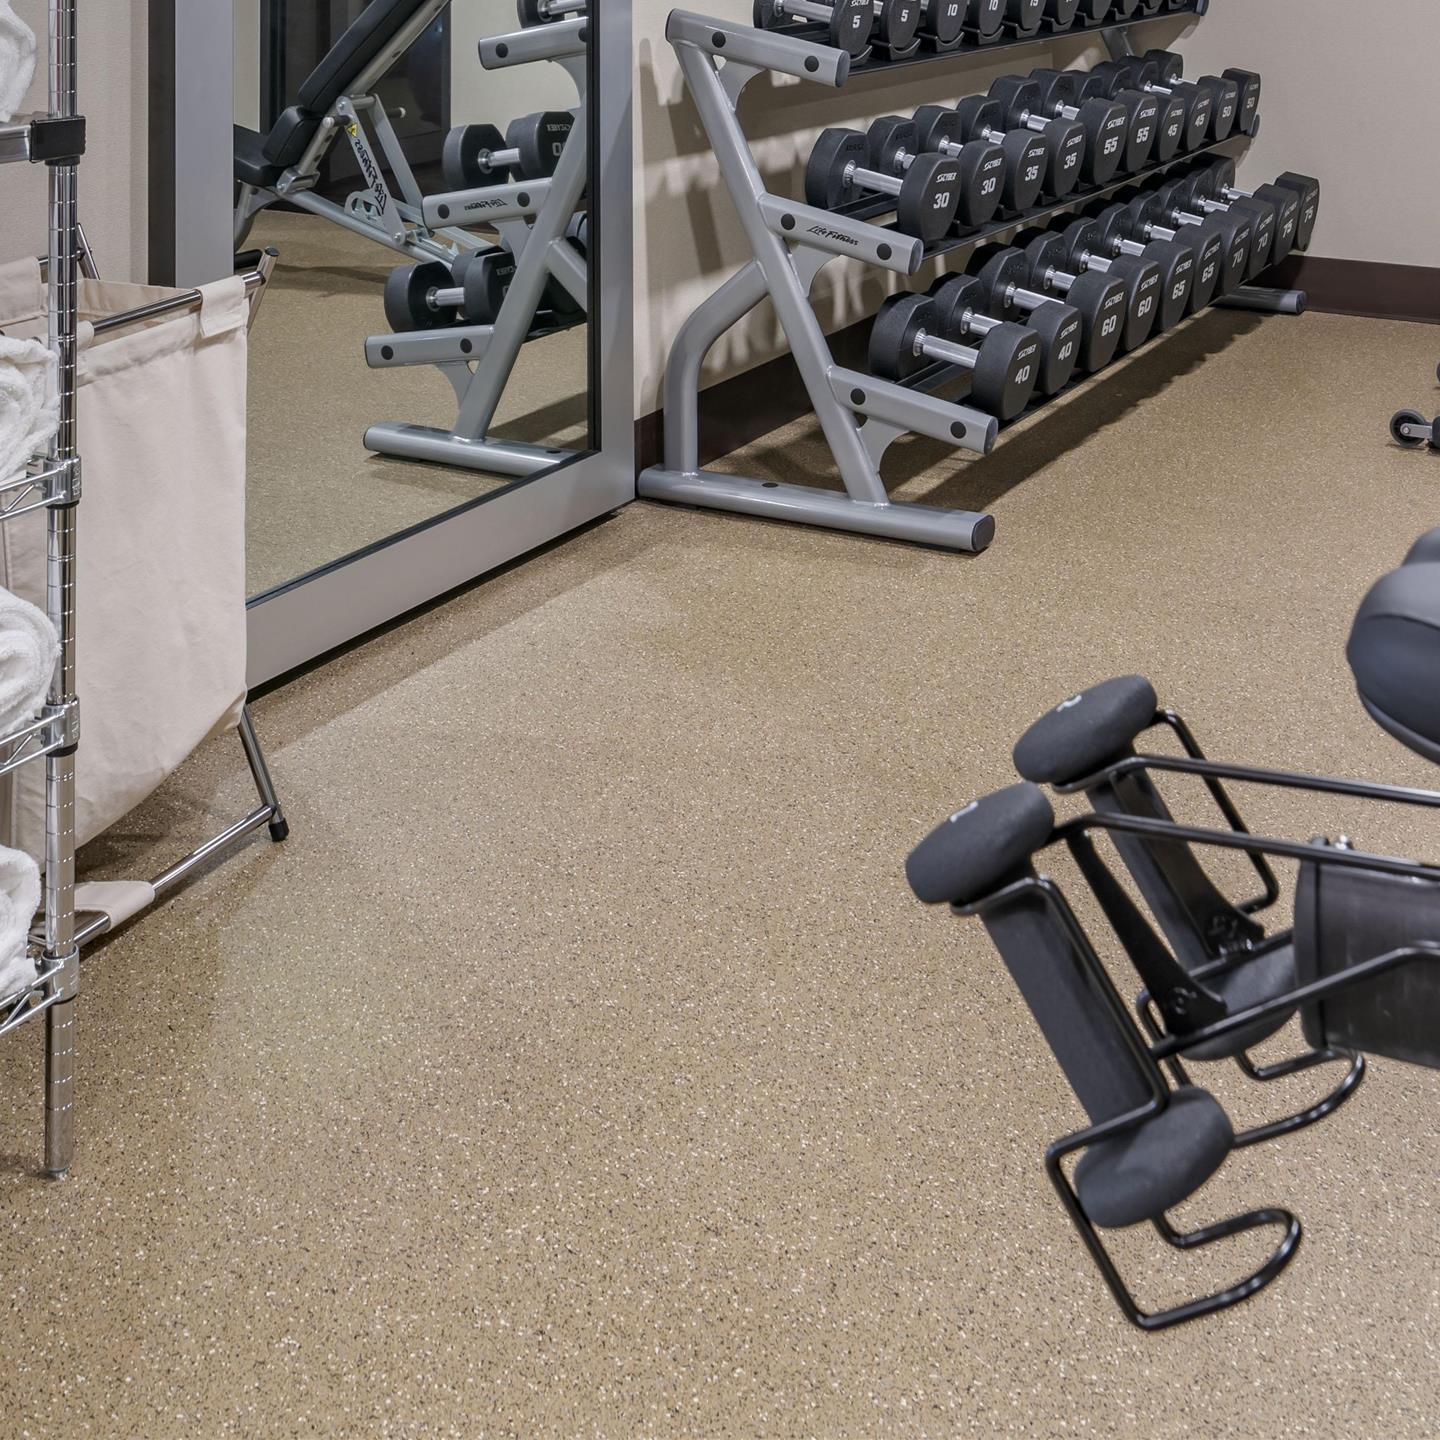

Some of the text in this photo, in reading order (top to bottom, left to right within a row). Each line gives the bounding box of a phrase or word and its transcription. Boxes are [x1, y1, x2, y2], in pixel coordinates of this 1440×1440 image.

[947, 4, 958, 16] 10
[988, 0, 999, 11] 10
[852, 15, 861, 29] 5
[901, 9, 909, 22] 5
[1195, 113, 1206, 127] 45
[1222, 106, 1232, 118] 50
[1136, 126, 1150, 143] 55
[1167, 124, 1178, 137] 45
[1103, 136, 1119, 155] 55
[1064, 152, 1078, 169] 35
[1025, 165, 1039, 181] 35
[981, 177, 997, 195] 30
[933, 192, 950, 209] 30
[1282, 219, 1294, 239] 75
[1257, 232, 1269, 252] 70
[1232, 248, 1244, 268] 70
[1201, 262, 1215, 283] 65
[1172, 280, 1186, 300] 65
[1137, 296, 1153, 317] 60
[1101, 315, 1117, 337] 60
[1058, 341, 1073, 360] 40
[1015, 365, 1031, 384] 40
